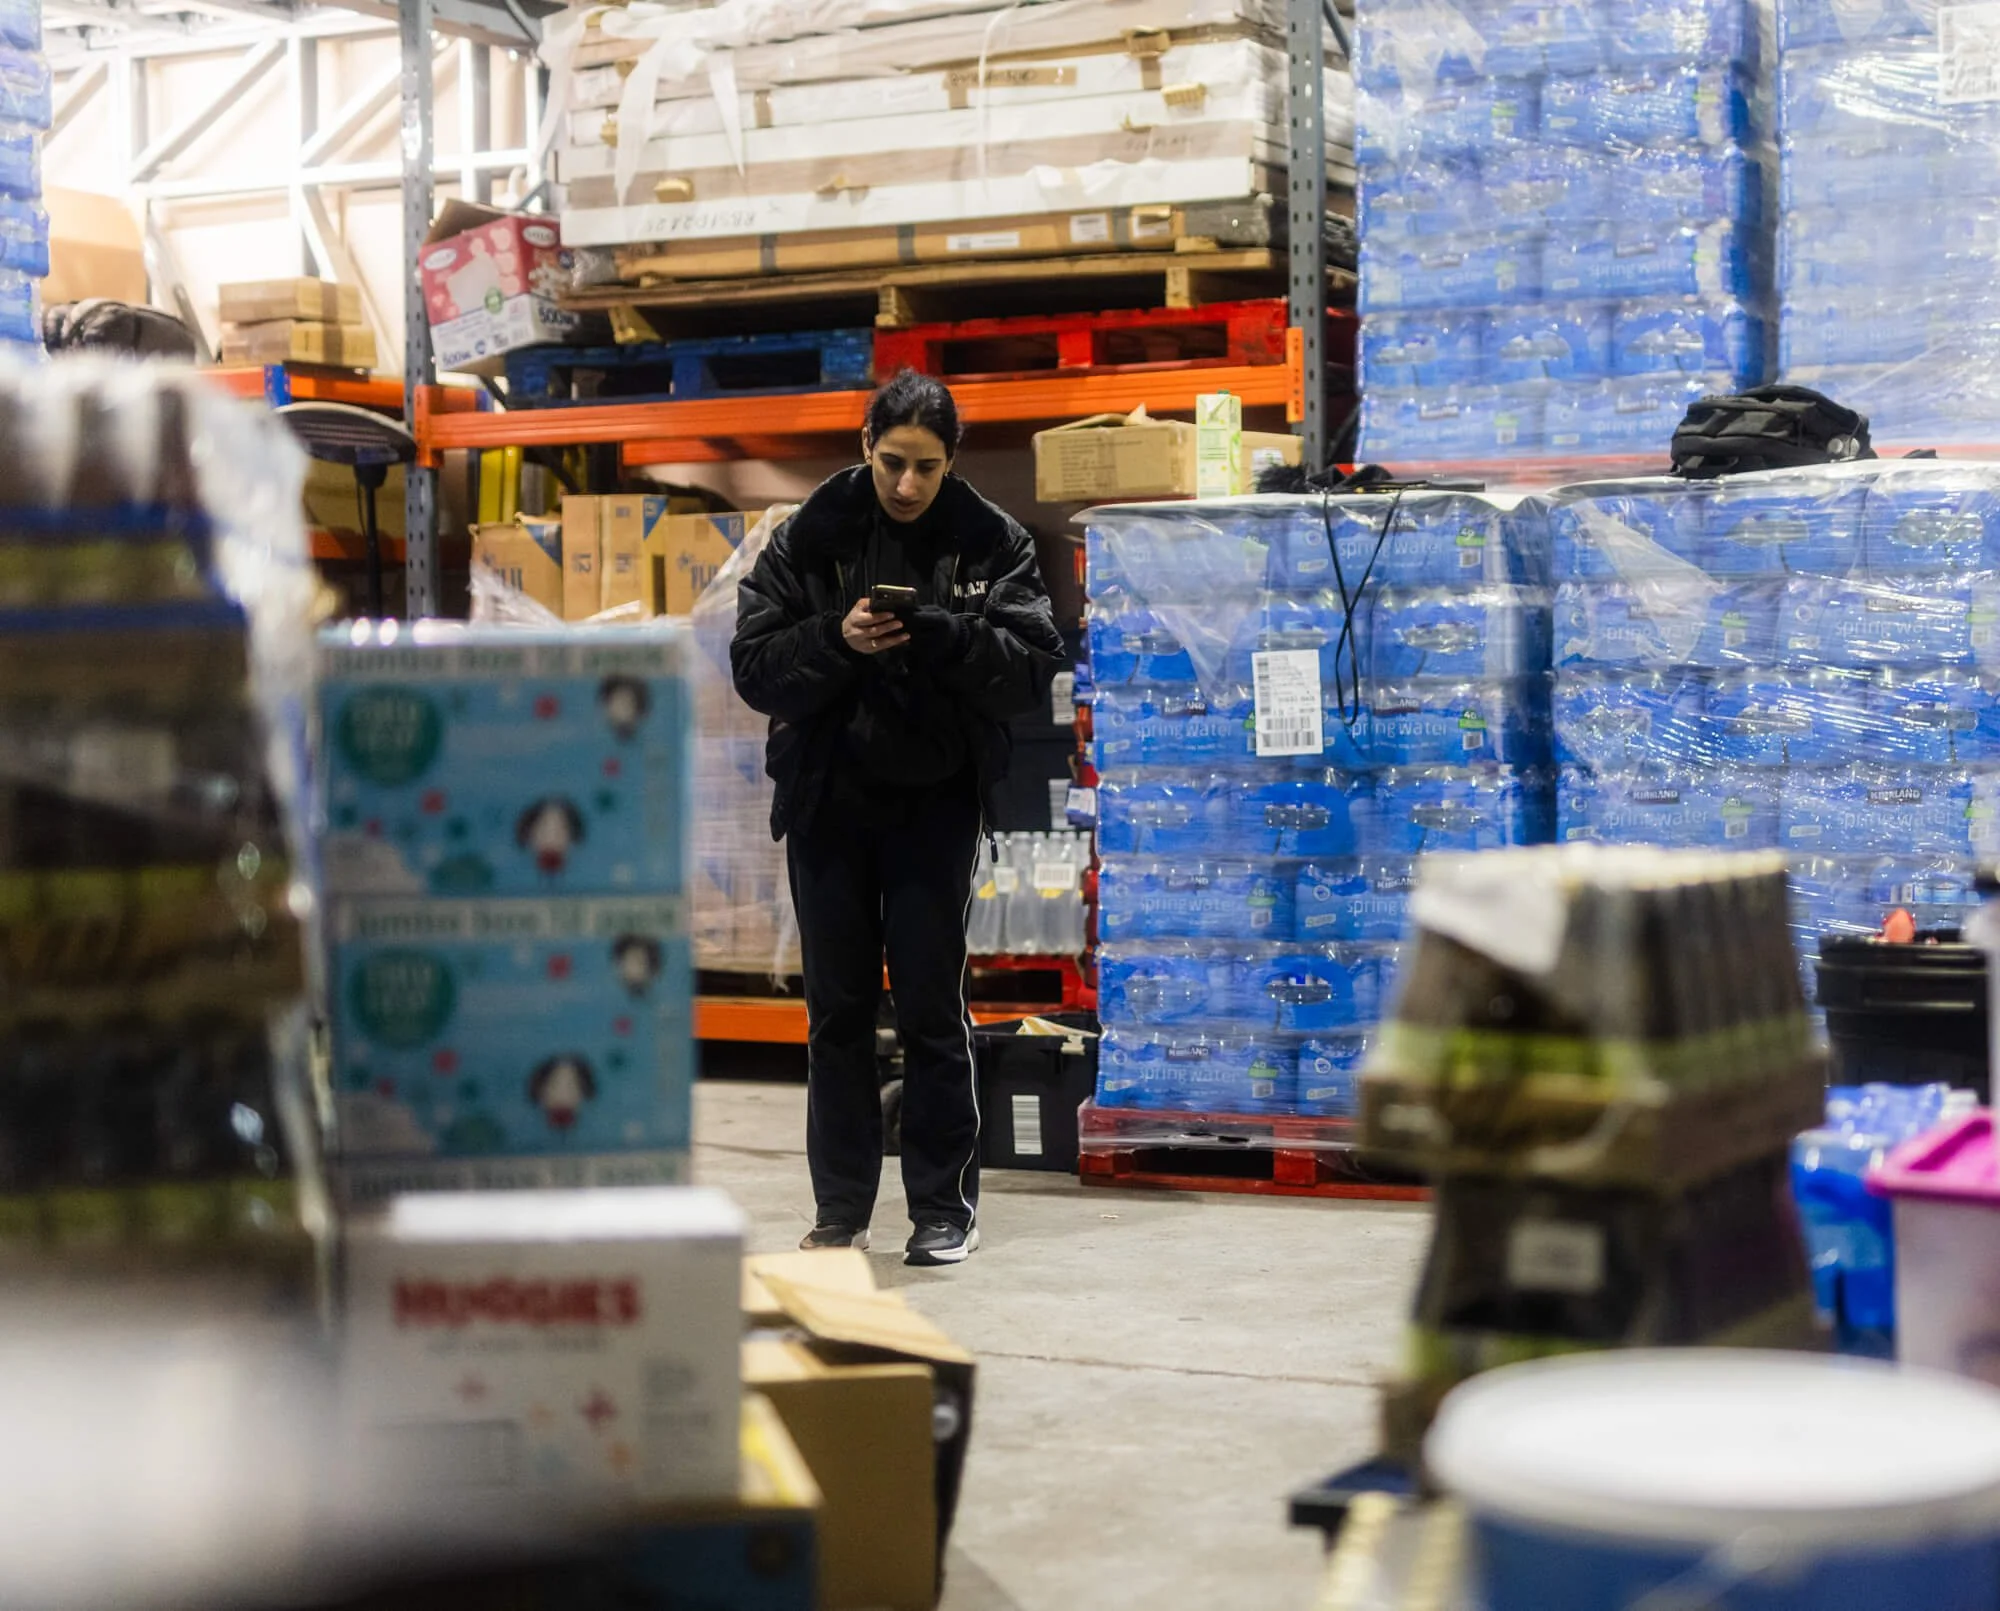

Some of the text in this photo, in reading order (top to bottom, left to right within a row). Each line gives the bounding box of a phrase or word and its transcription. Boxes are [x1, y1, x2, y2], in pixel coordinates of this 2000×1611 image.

[1641, 414, 1678, 431] wate
[1338, 536, 1443, 559] spring water
[1836, 613, 1951, 639] spring water
[1463, 711, 1477, 720] 40
[1135, 722, 1232, 740] spring water
[1399, 720, 1447, 737] water
[1632, 788, 1679, 800] KIRKLAND
[1870, 788, 1921, 801] KIRKLAND
[1658, 808, 1709, 827] water
[1838, 808, 1892, 831] spr
[1142, 897, 1187, 914] spring
[1346, 897, 1398, 917] spring
[1139, 1066, 1239, 1084] spring water
